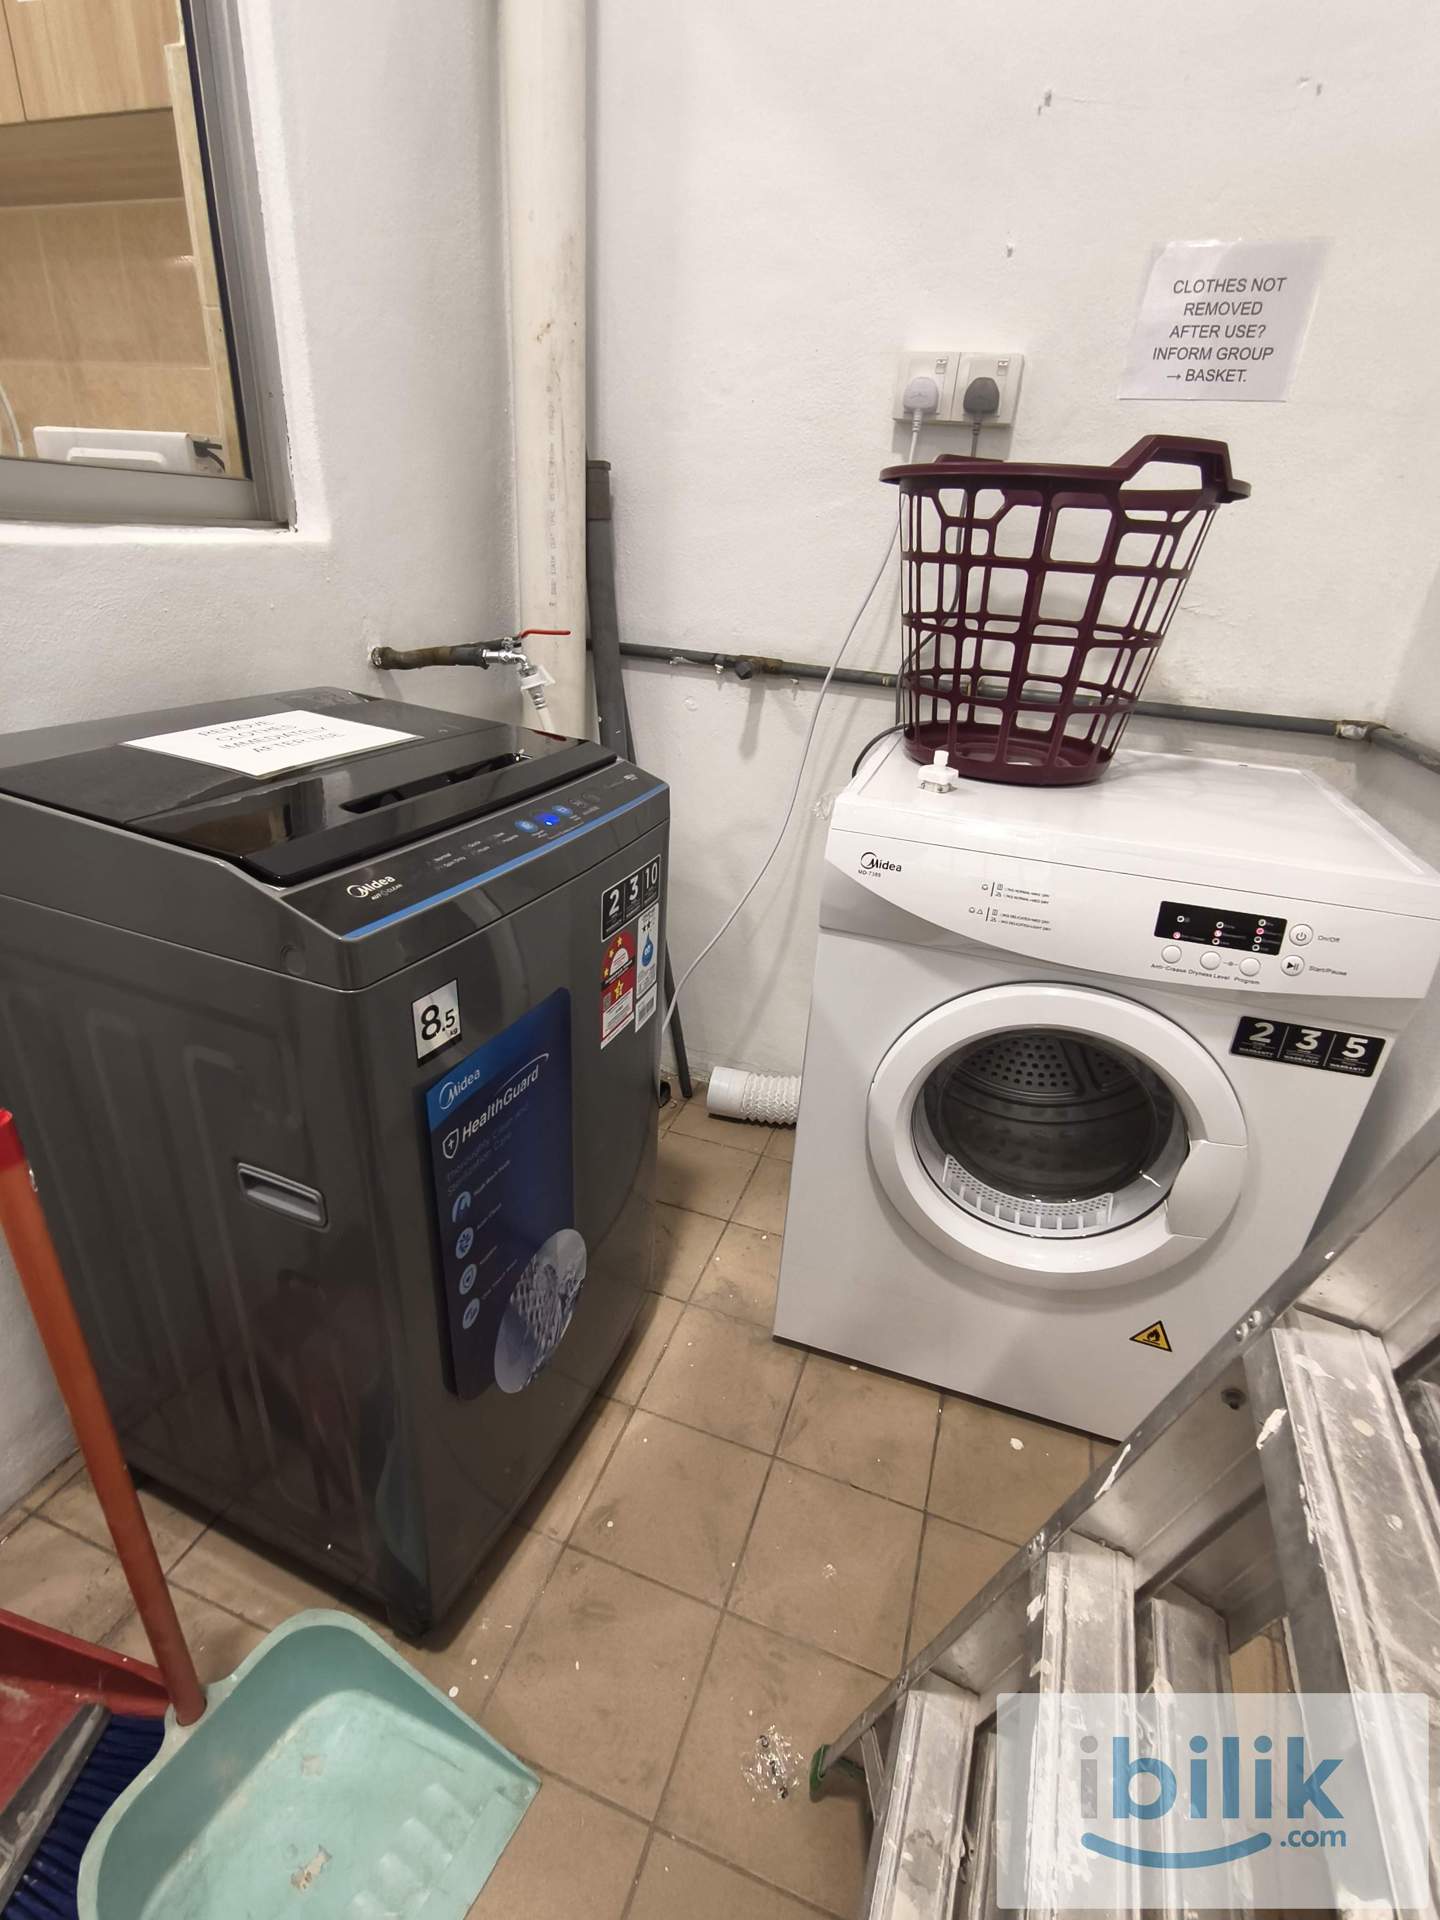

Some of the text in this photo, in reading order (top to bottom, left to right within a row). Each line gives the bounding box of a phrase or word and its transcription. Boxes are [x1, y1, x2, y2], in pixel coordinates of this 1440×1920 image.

[1173, 278, 1287, 294] CLOTHES NOT
[1184, 302, 1263, 316] REMOVED
[1169, 324, 1266, 338] AFTER USE?
[1152, 347, 1274, 360] INFORM GROUP
[1185, 369, 1247, 382] BASKET.
[861, 852, 902, 872] Midea
[346, 876, 396, 899] Midea
[608, 889, 620, 916] 2
[629, 875, 639, 901] 3
[645, 862, 658, 889] 10
[1213, 973, 1231, 981] Level
[1309, 965, 1348, 977] Start/Pause
[421, 1005, 455, 1041] 8.5
[1249, 1022, 1274, 1043] 2
[1296, 1029, 1322, 1051] 3
[1342, 1036, 1369, 1059] 5
[439, 1069, 480, 1110] Midea
[462, 1064, 539, 1143] HealthGuard
